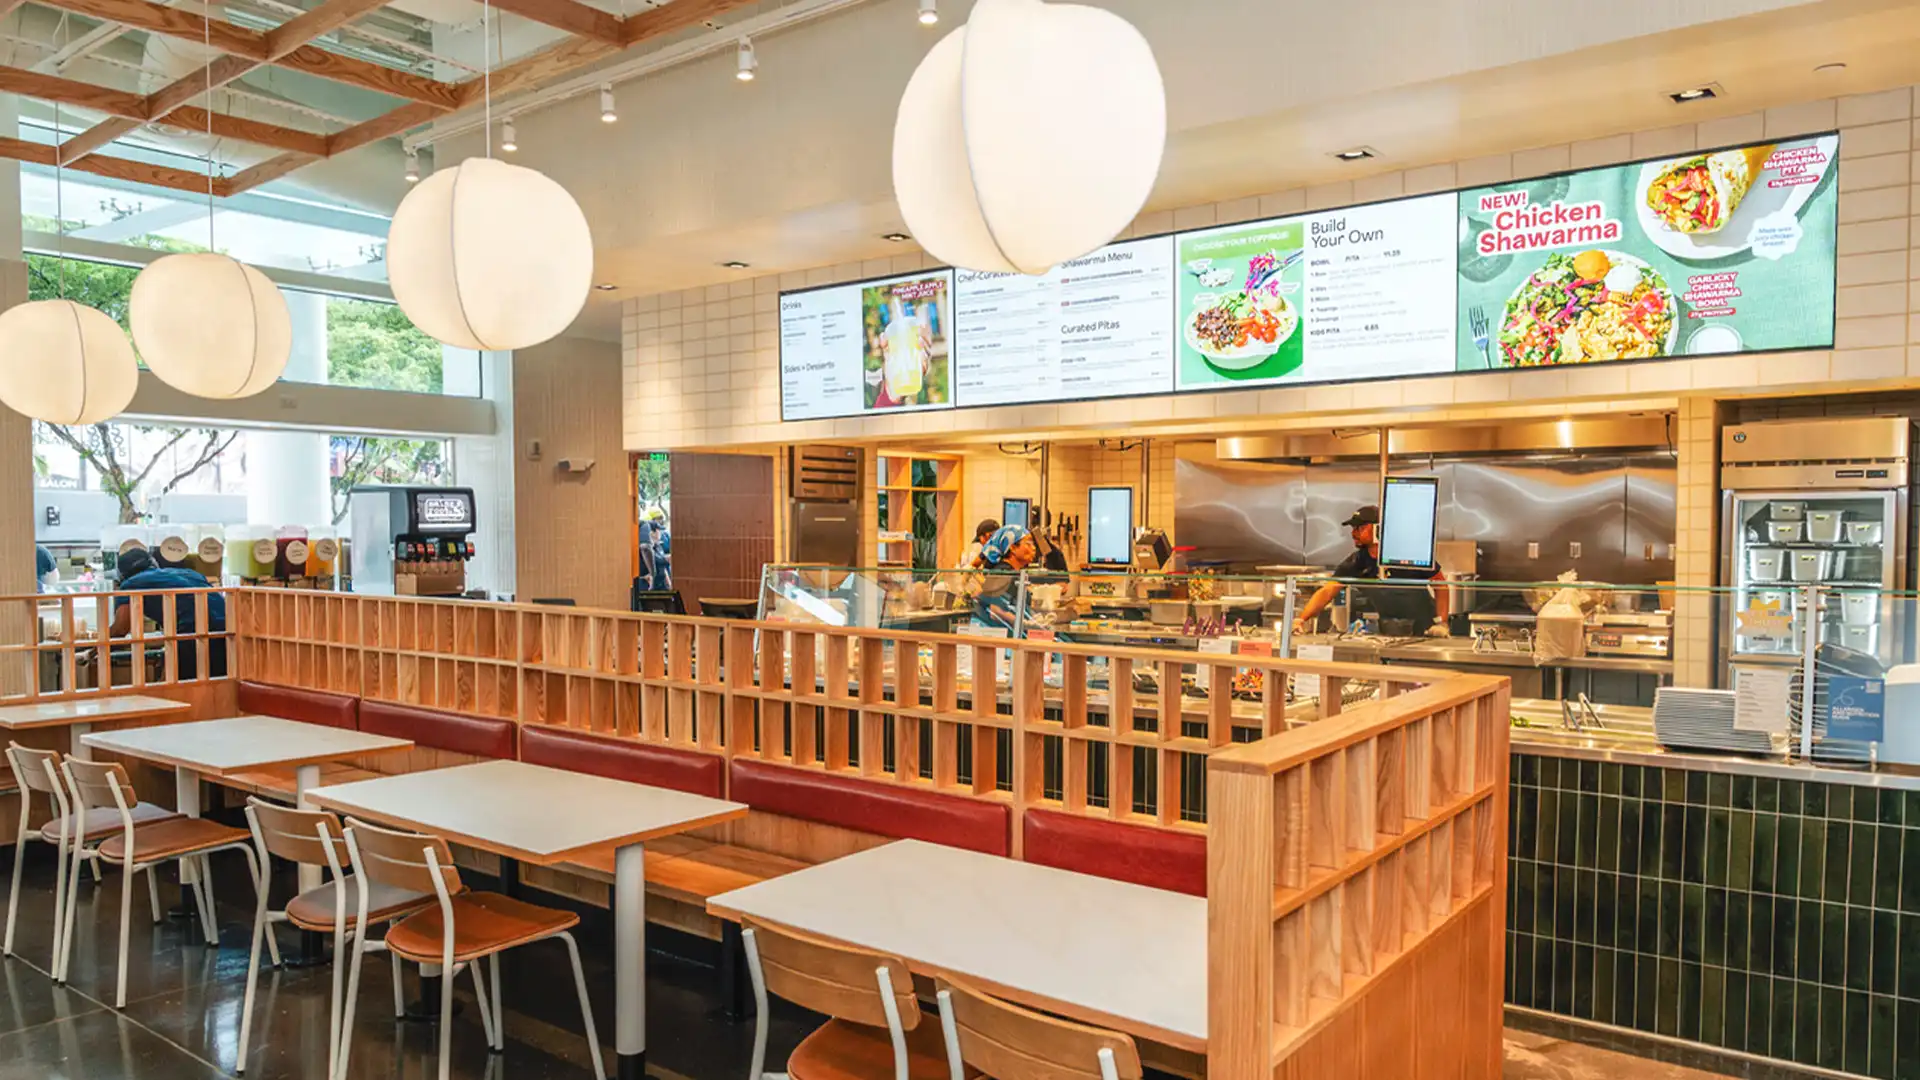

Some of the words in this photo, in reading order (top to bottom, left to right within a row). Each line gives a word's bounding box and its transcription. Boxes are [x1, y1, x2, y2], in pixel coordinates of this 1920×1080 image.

[1772, 147, 1817, 160] CHICKEN
[1763, 155, 1826, 168] SHAWARMA
[1781, 164, 1806, 175] PITA
[1481, 192, 1526, 210] NEW!
[1496, 204, 1601, 230] Chicken
[1311, 217, 1346, 235] Build
[1311, 234, 1344, 248] Your
[1348, 229, 1384, 244] Own
[1480, 222, 1617, 253] Shawarma
[1061, 255, 1106, 269] Shawarma
[1107, 251, 1133, 262] Menu
[1310, 259, 1331, 267] BOWL
[1345, 254, 1360, 262] PITA
[1689, 272, 1736, 284] GARLICKY
[1692, 281, 1733, 291] CHICKEN
[1684, 289, 1741, 301] SHAWARMA
[1697, 298, 1727, 308] BOWL
[1061, 321, 1096, 335] Curated
[1098, 320, 1120, 331] Pitas
[784, 364, 801, 374] Sides
[806, 361, 835, 371] Desserts
